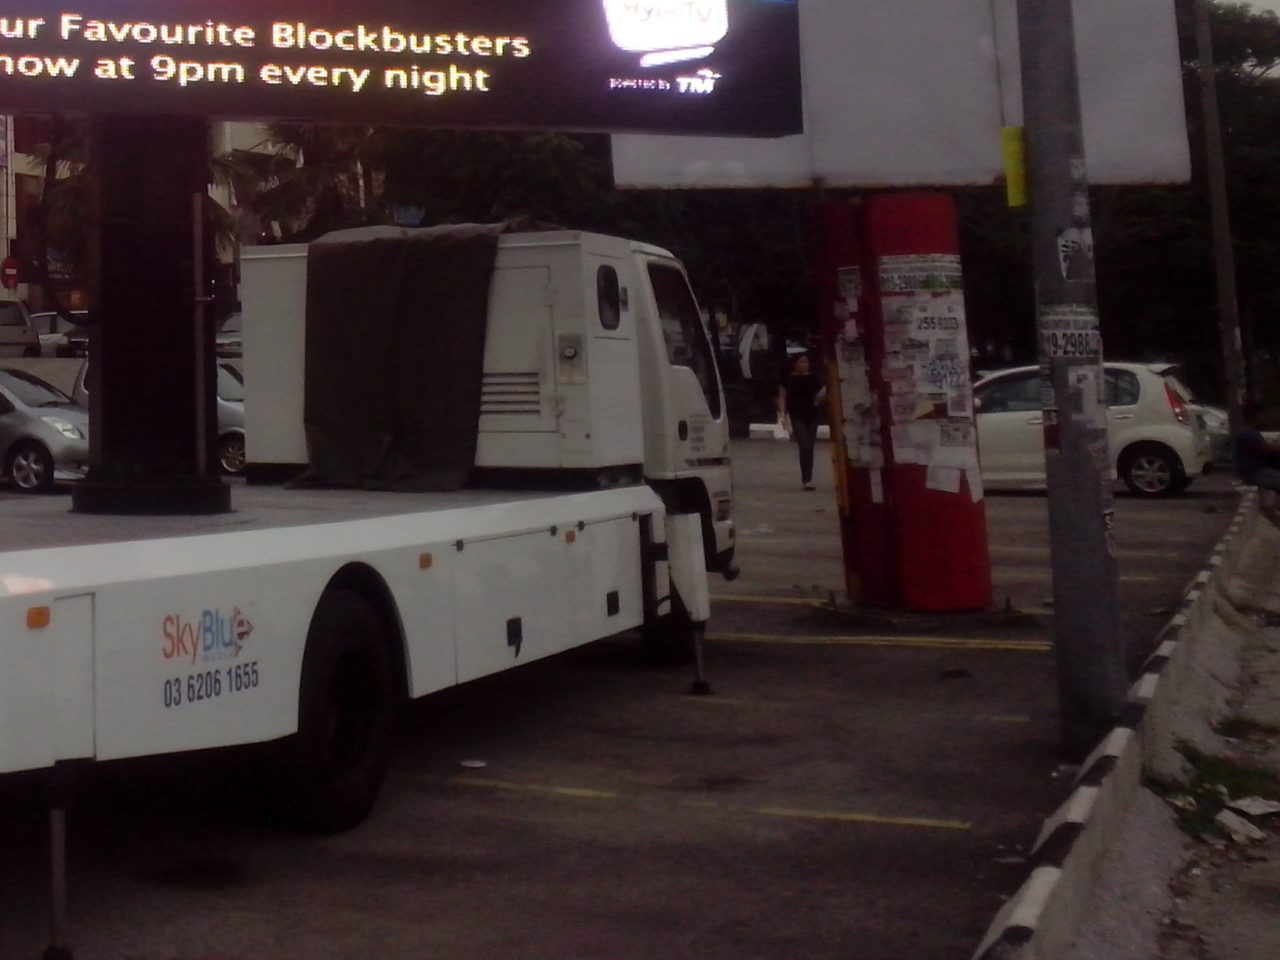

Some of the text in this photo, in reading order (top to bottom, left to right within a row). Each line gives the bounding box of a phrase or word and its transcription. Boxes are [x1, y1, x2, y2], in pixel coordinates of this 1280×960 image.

[60, 12, 256, 48] Favourite
[271, 21, 531, 58] Blockbusters
[94, 55, 136, 81] at
[150, 54, 245, 87] 9pm
[259, 63, 370, 93] every
[384, 64, 491, 97] night
[164, 661, 259, 708] 03 6206 1655
